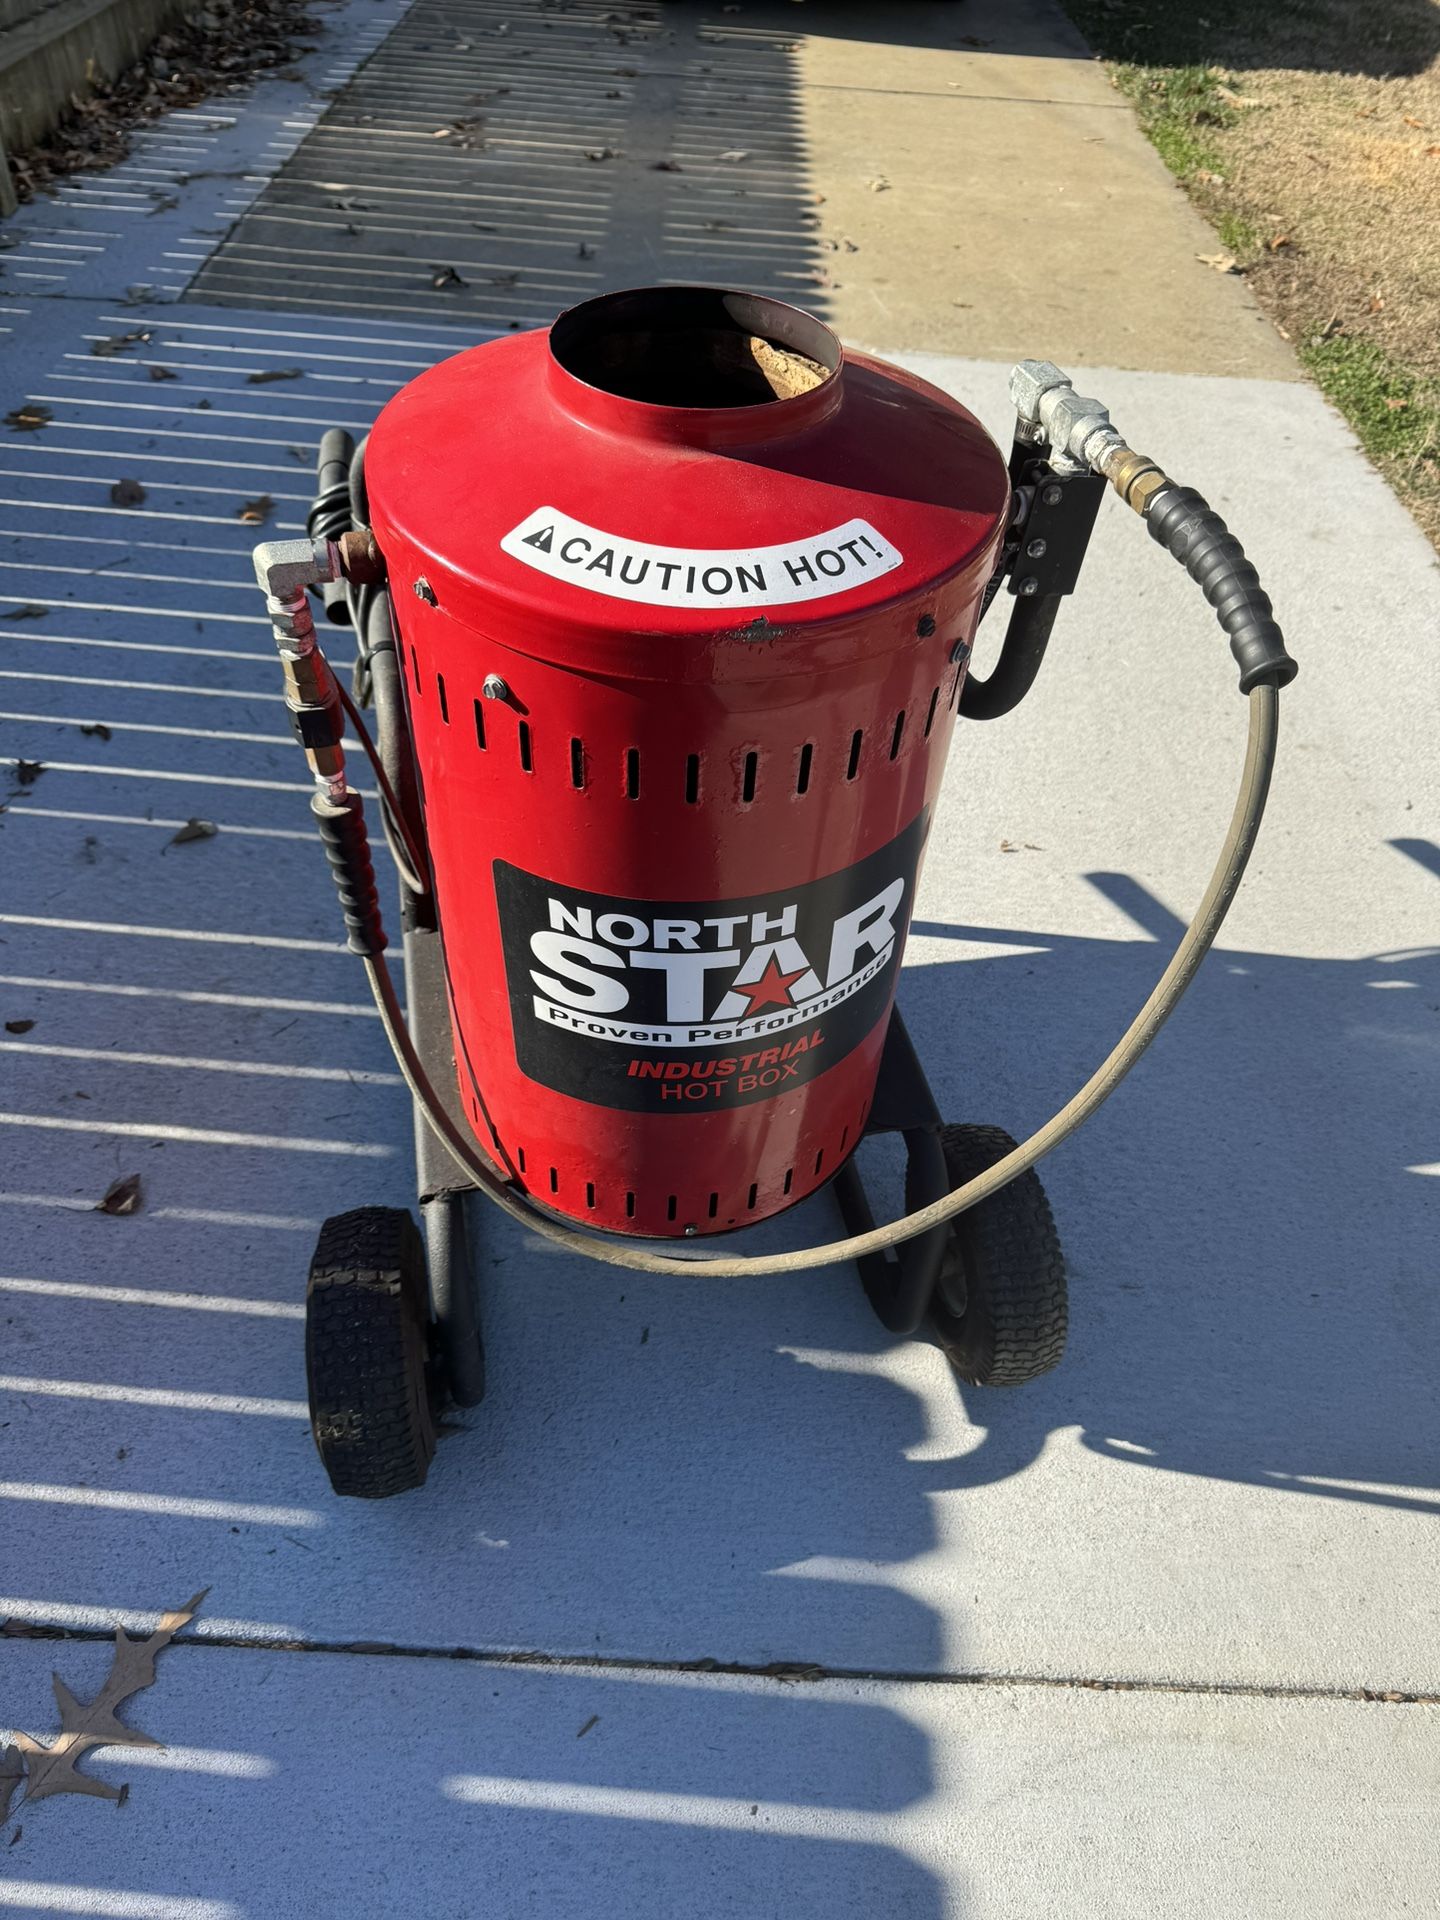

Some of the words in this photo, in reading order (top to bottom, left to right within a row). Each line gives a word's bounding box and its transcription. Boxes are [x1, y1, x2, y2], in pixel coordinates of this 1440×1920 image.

[560, 538, 767, 595] CAUTION
[783, 535, 883, 586] HOT!
[529, 877, 905, 1023] STAR
[547, 898, 798, 949] NORTH
[549, 1008, 672, 1042] Proven
[688, 953, 888, 1042] Performance
[627, 1029, 826, 1080] INDUSTRIAL
[661, 1080, 728, 1100] HOT
[737, 1060, 800, 1093] BOX
